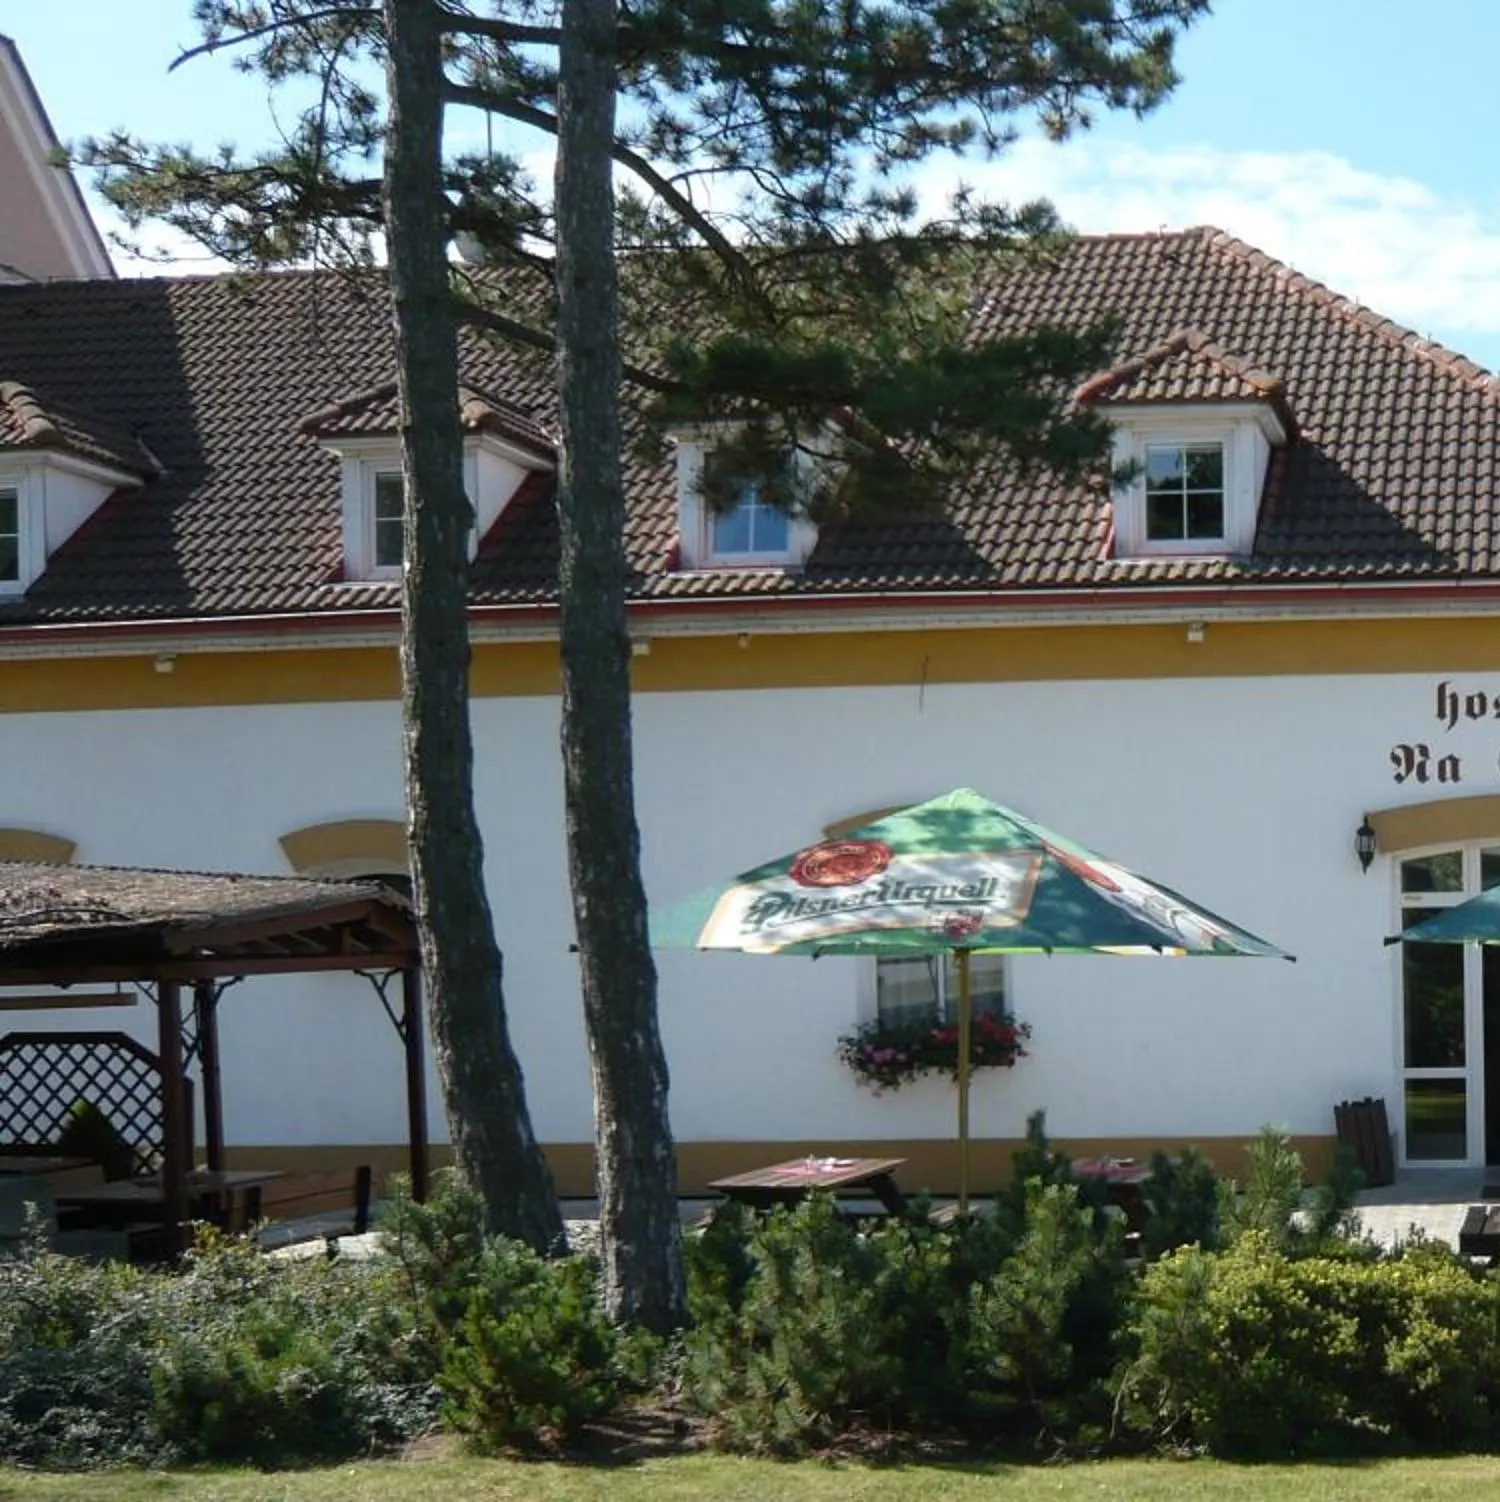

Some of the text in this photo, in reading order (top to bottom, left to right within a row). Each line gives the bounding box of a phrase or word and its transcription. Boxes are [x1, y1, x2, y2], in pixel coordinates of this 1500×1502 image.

[1389, 743, 1462, 784] Na
[741, 876, 999, 935] Pilsner Urquell
